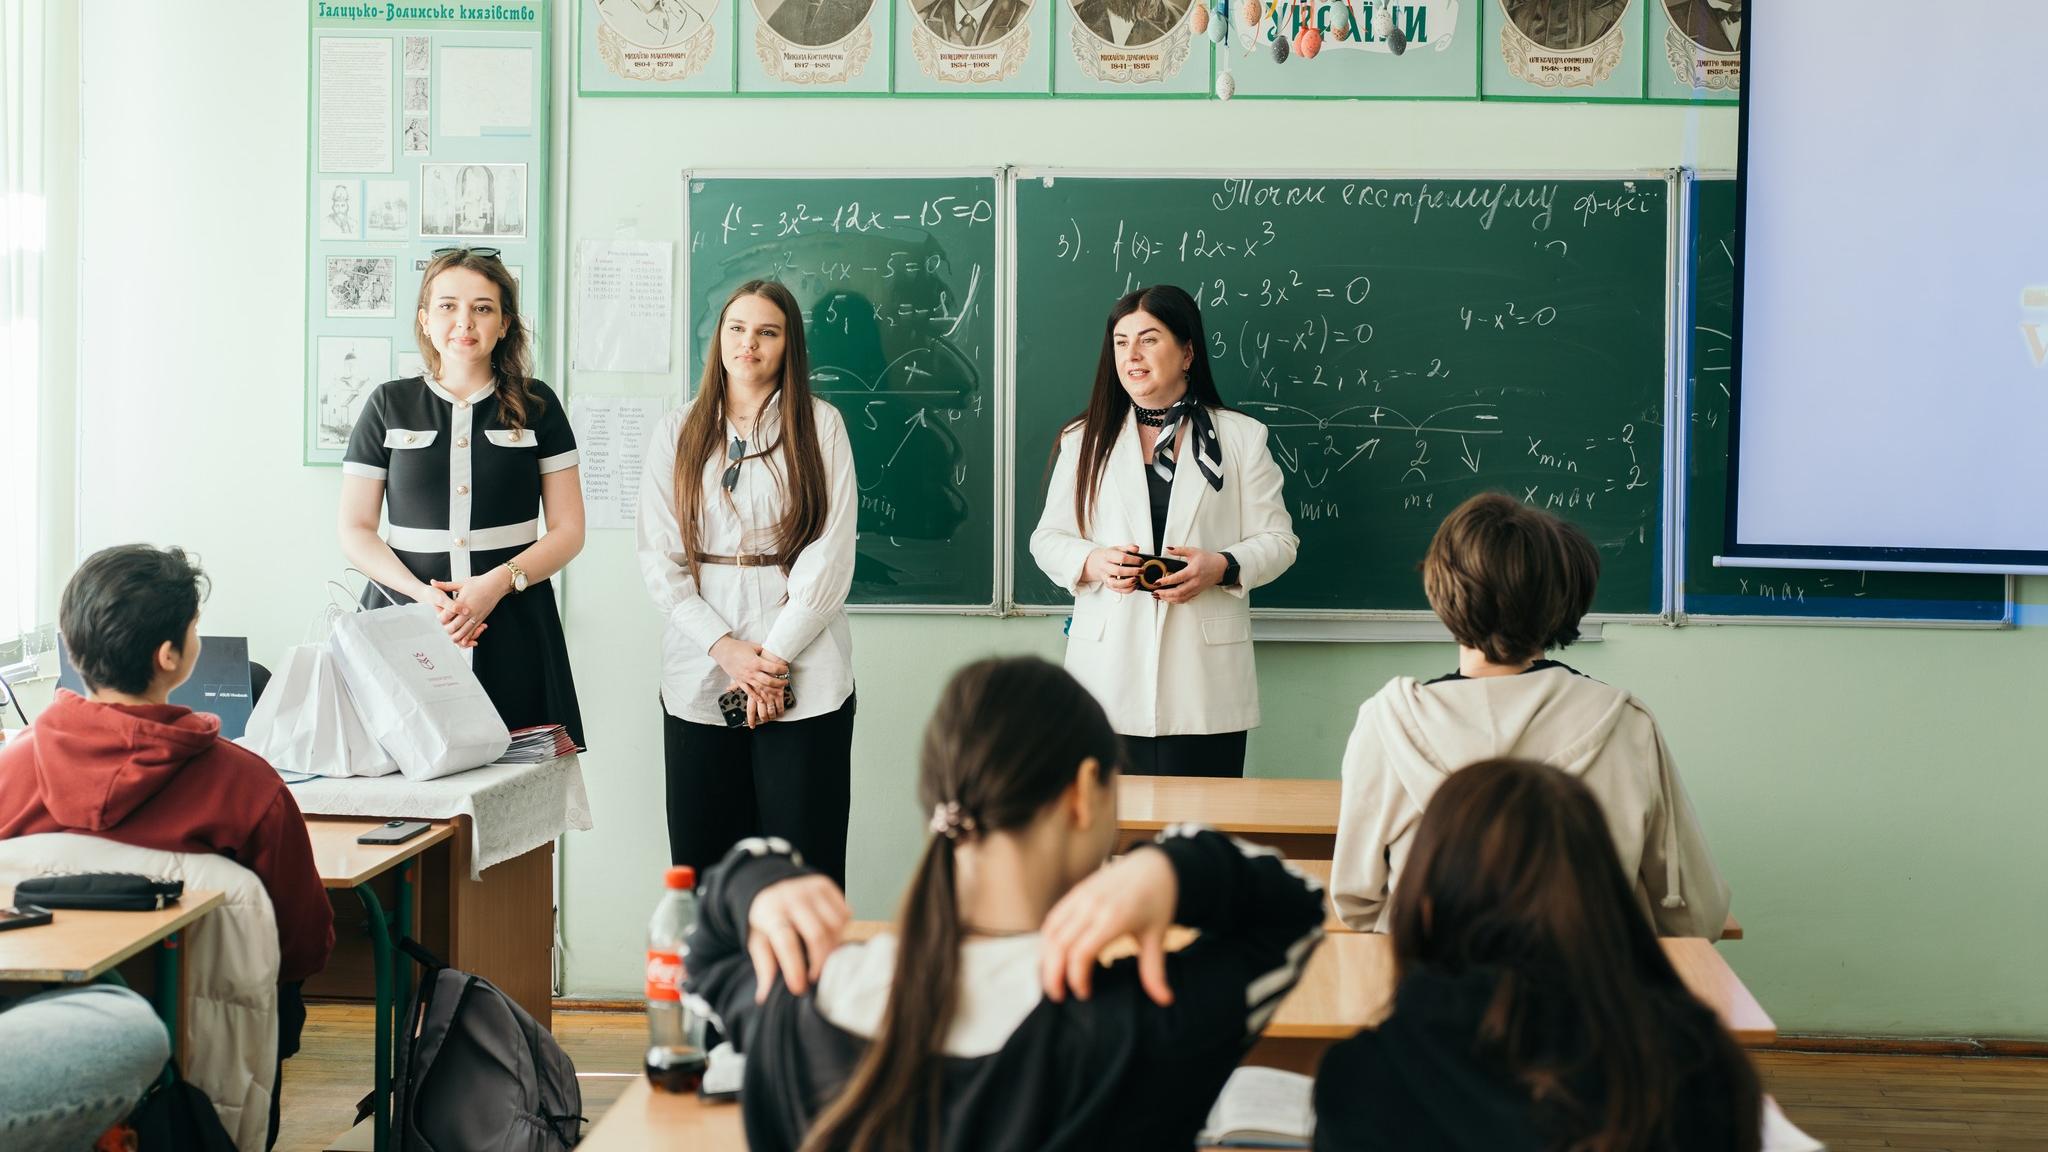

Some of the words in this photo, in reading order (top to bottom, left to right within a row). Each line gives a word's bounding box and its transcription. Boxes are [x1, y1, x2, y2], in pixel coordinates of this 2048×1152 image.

[319, 2, 455, 21] Галицько-Волинське
[460, 5, 535, 21] князівство
[1212, 177, 1326, 211] Точки
[1342, 184, 1558, 231] екстремуму
